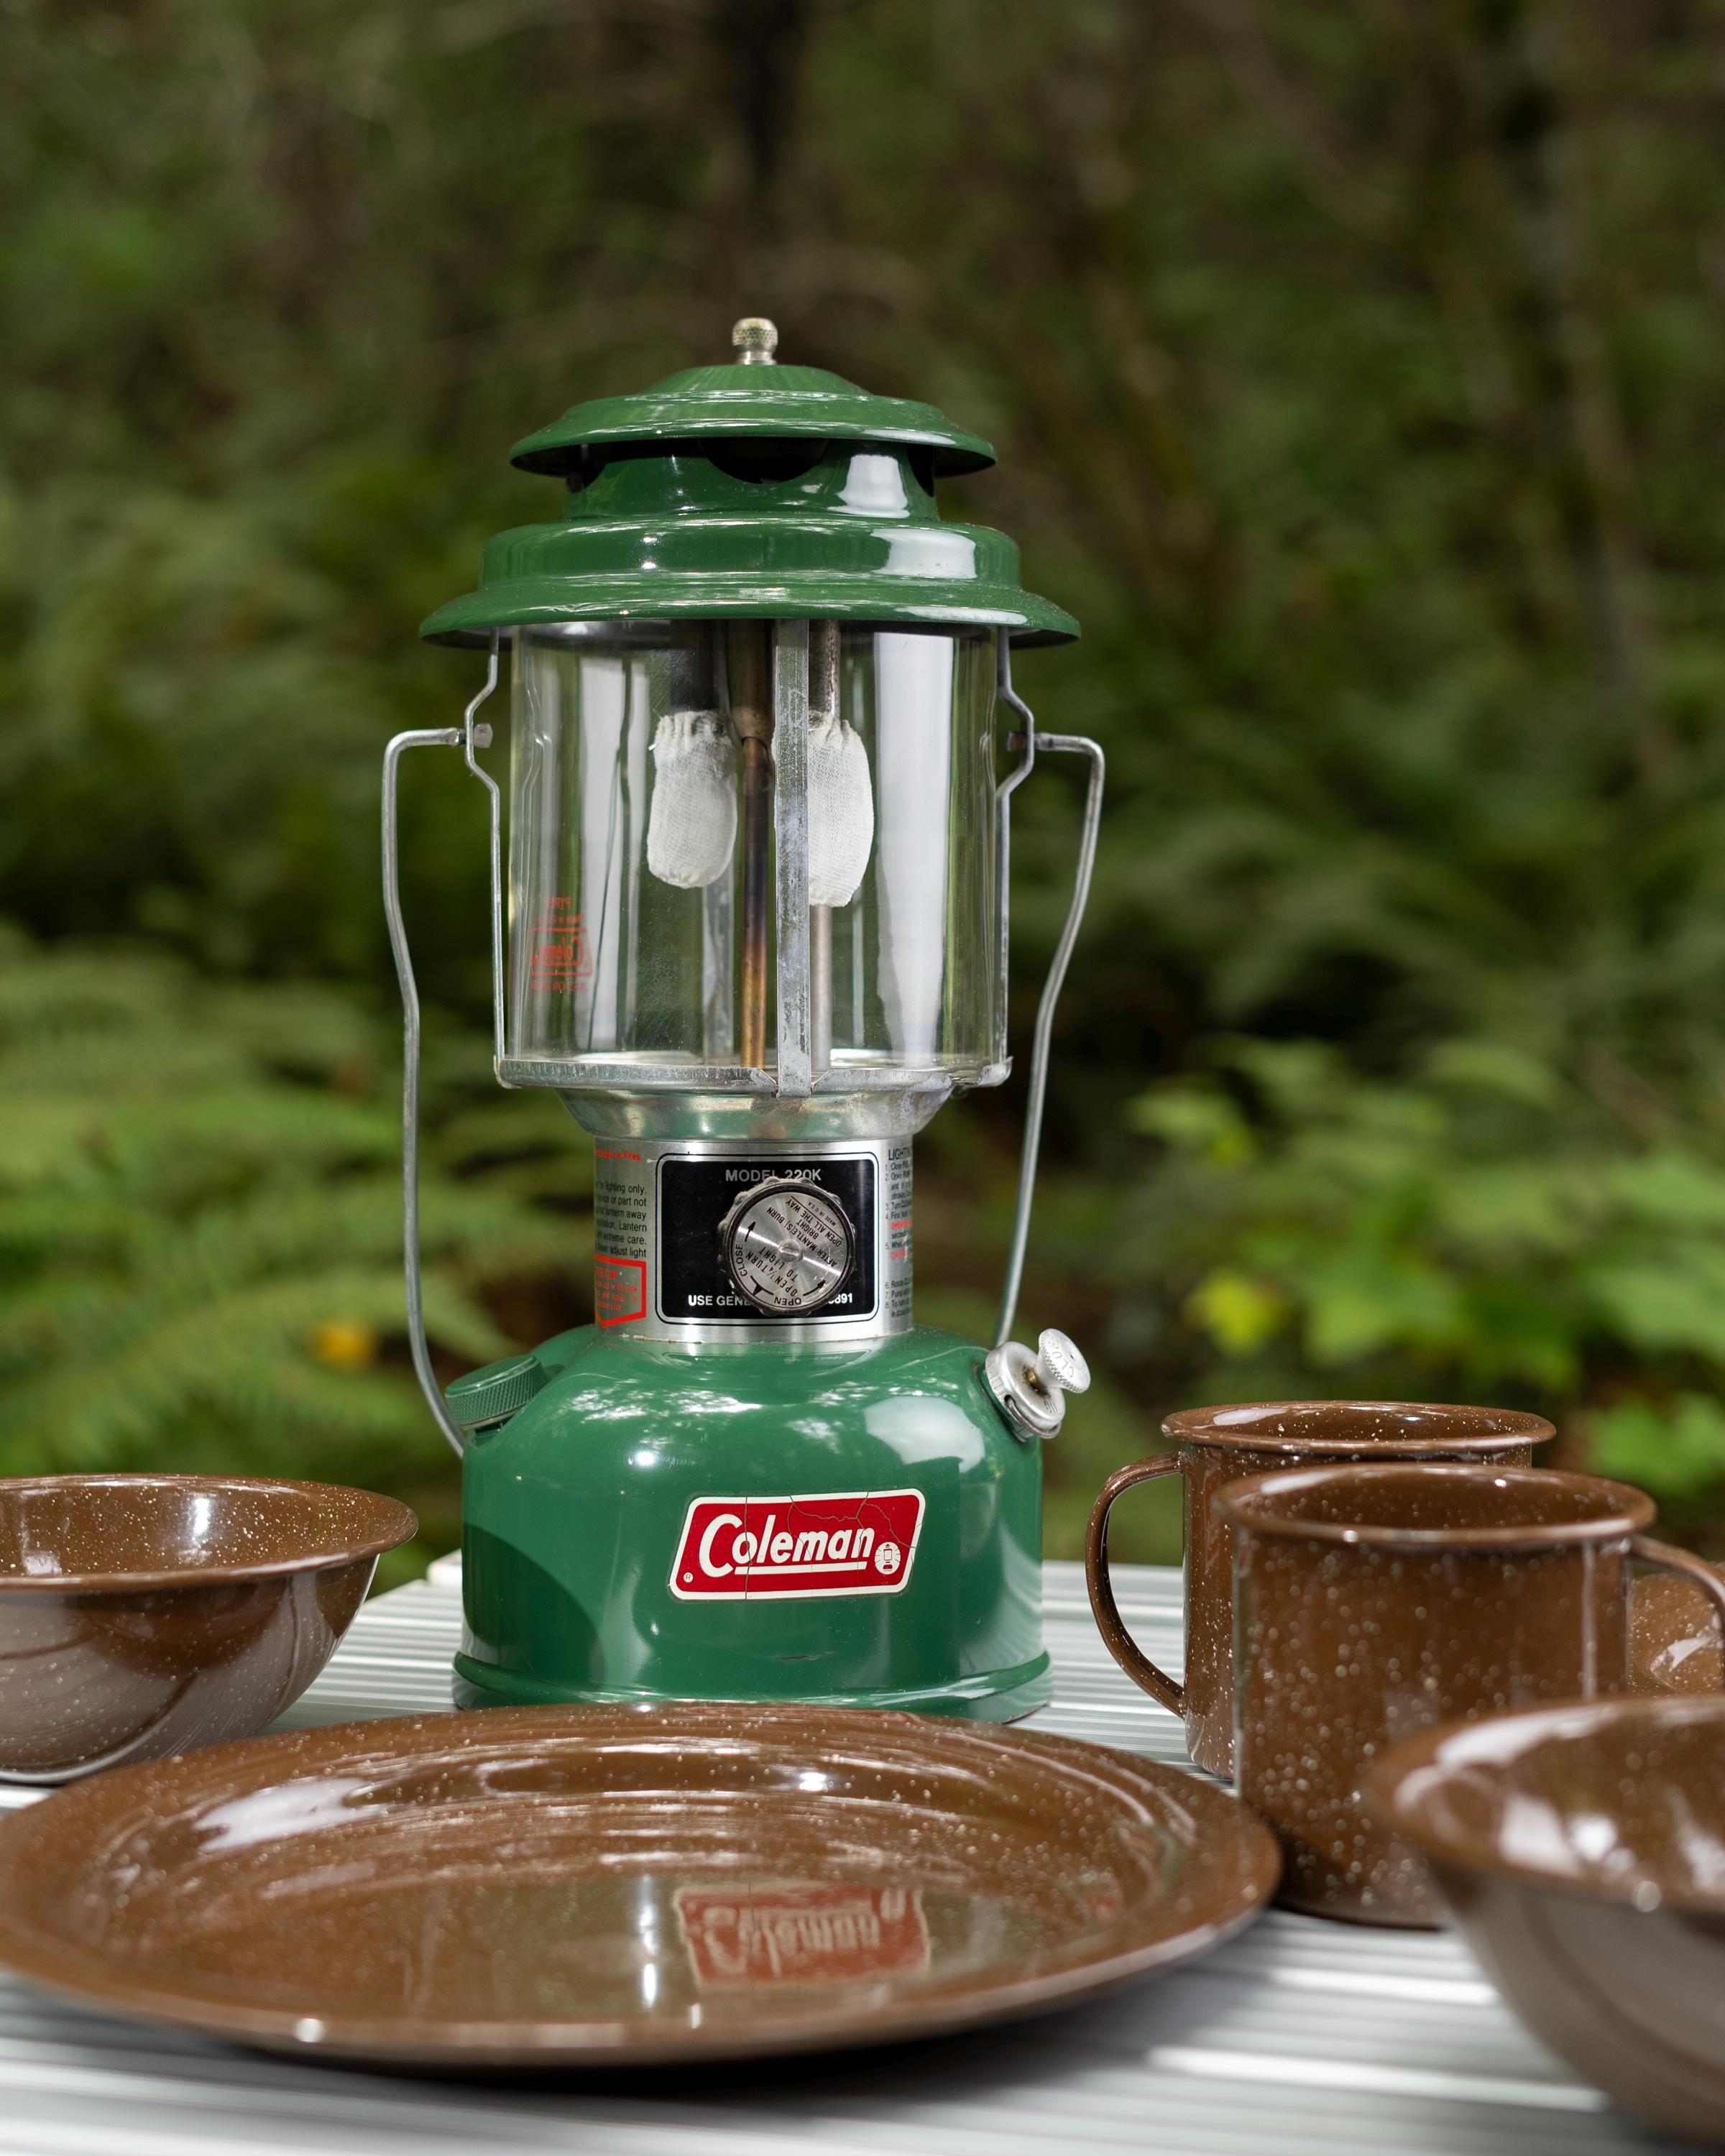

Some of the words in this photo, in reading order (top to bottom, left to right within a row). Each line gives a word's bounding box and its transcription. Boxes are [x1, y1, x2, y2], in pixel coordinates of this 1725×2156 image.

[785, 1169, 822, 1181] 220K
[628, 1184, 647, 1195] only.
[618, 1197, 631, 1206] part
[634, 1198, 647, 1207] not
[786, 1200, 801, 1212] WAY
[627, 1210, 646, 1221] away
[767, 1207, 786, 1224] BURN
[801, 1211, 814, 1222] THE
[826, 1217, 836, 1225] MADE
[619, 1221, 647, 1232] Lantern
[796, 1221, 819, 1239] BRIGHT
[812, 1222, 826, 1233] ALL
[627, 1235, 647, 1245] care.
[785, 1221, 817, 1252] MANTLE(S)
[826, 1232, 842, 1247] OPEN
[610, 1245, 627, 1256] adjust
[630, 1247, 646, 1258] light
[759, 1247, 785, 1268] LIGHT
[736, 1245, 748, 1276] CLOSE
[746, 1252, 766, 1273] TURN
[817, 1250, 837, 1267] AFTER
[786, 1269, 798, 1281] TO
[776, 1276, 797, 1296] OPEN
[689, 1295, 713, 1306] USE
[774, 1294, 801, 1305] OPEN
[699, 1514, 875, 1577] Coleman
